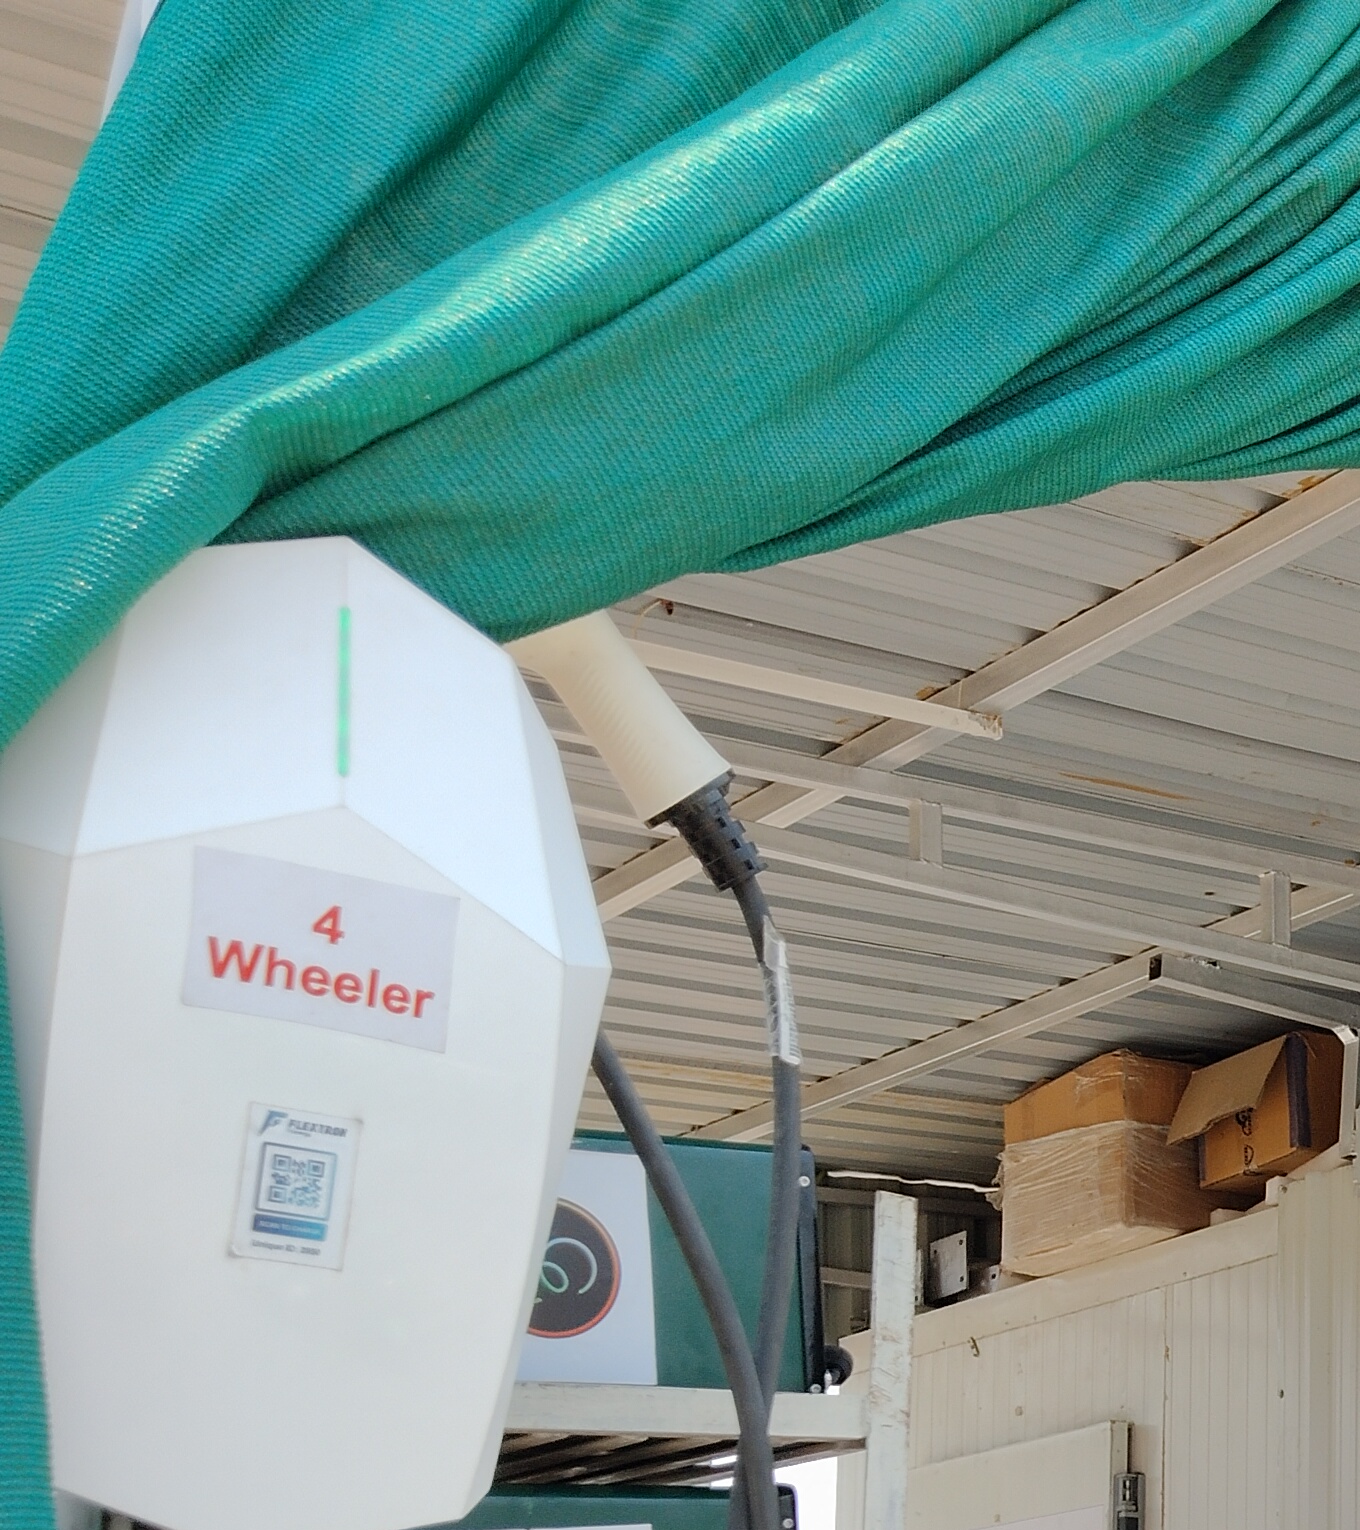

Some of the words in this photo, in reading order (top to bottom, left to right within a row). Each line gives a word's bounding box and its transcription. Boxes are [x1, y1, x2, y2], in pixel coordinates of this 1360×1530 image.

[312, 904, 345, 945] 4
[207, 935, 435, 1018] Wheeler
[288, 1119, 348, 1138] FLEXTRON
